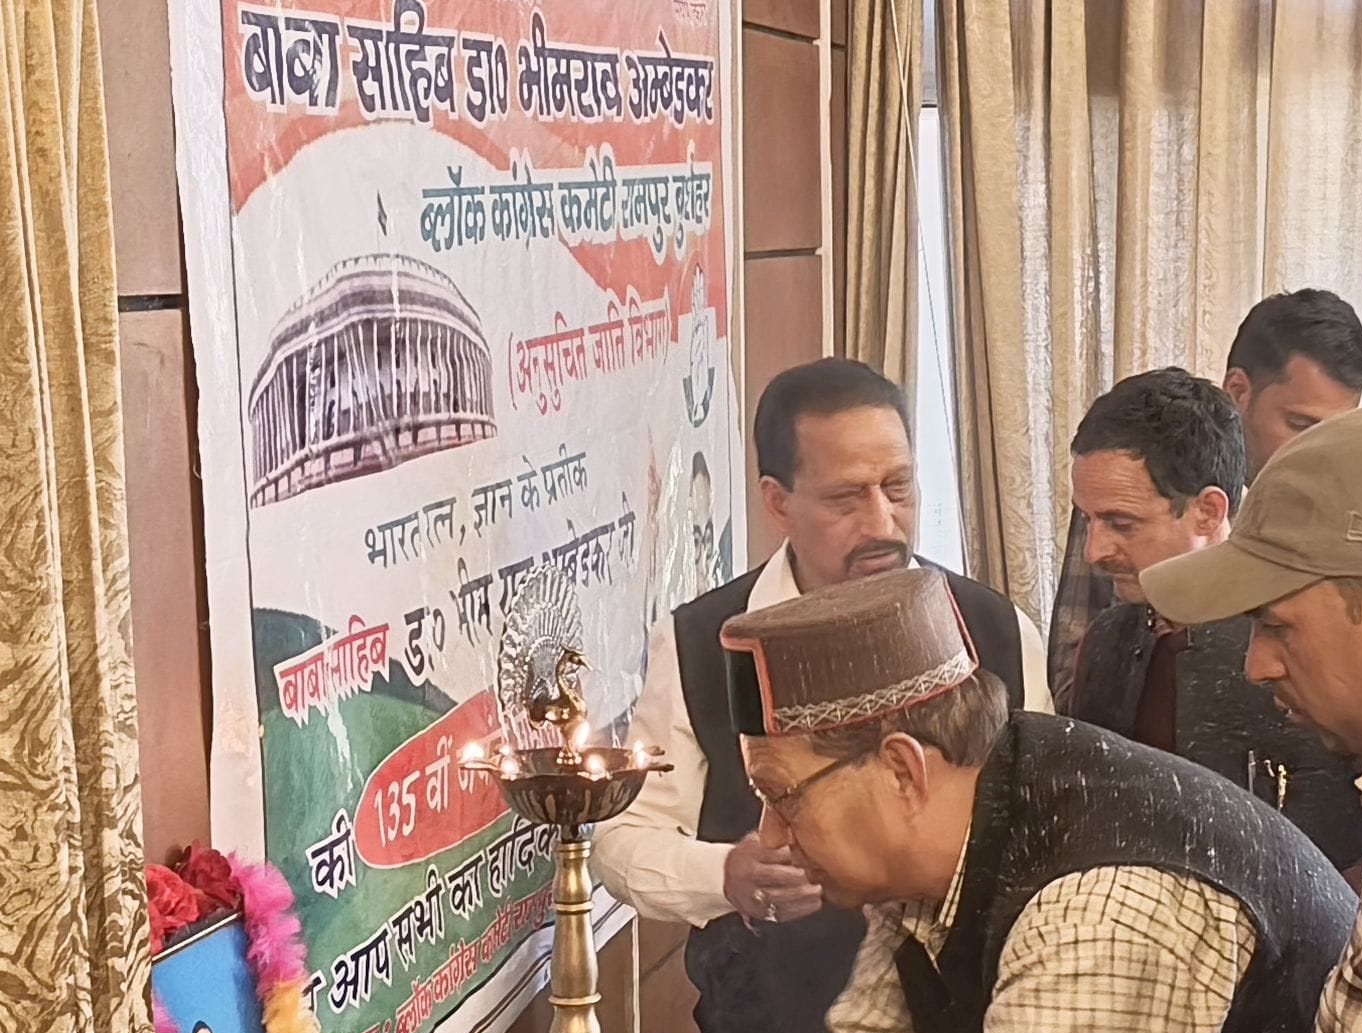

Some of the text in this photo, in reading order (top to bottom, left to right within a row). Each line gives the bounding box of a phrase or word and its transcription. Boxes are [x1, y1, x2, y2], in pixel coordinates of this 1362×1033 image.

[241, 10, 340, 108] बाबा
[346, 0, 457, 123] साहिब
[518, 11, 622, 119] भीमराव
[625, 30, 714, 125] अम्बेडकर
[420, 165, 486, 253] ब्लॉक
[490, 159, 555, 250] कांग्रेस
[558, 154, 618, 233] कमेटी
[621, 175, 672, 253] रामपुर
[587, 300, 625, 374] जाति
[471, 479, 513, 538] ज्ञान
[517, 454, 540, 512] के
[541, 443, 588, 506] प्रतीक
[448, 556, 494, 648] भीम
[541, 517, 616, 588] म्बेडकर
[311, 814, 354, 889] की
[374, 770, 421, 848] 135
[425, 735, 453, 813] वीं
[331, 928, 390, 1008] आप
[391, 868, 443, 965] सभी
[480, 897, 513, 965] कमेटी
